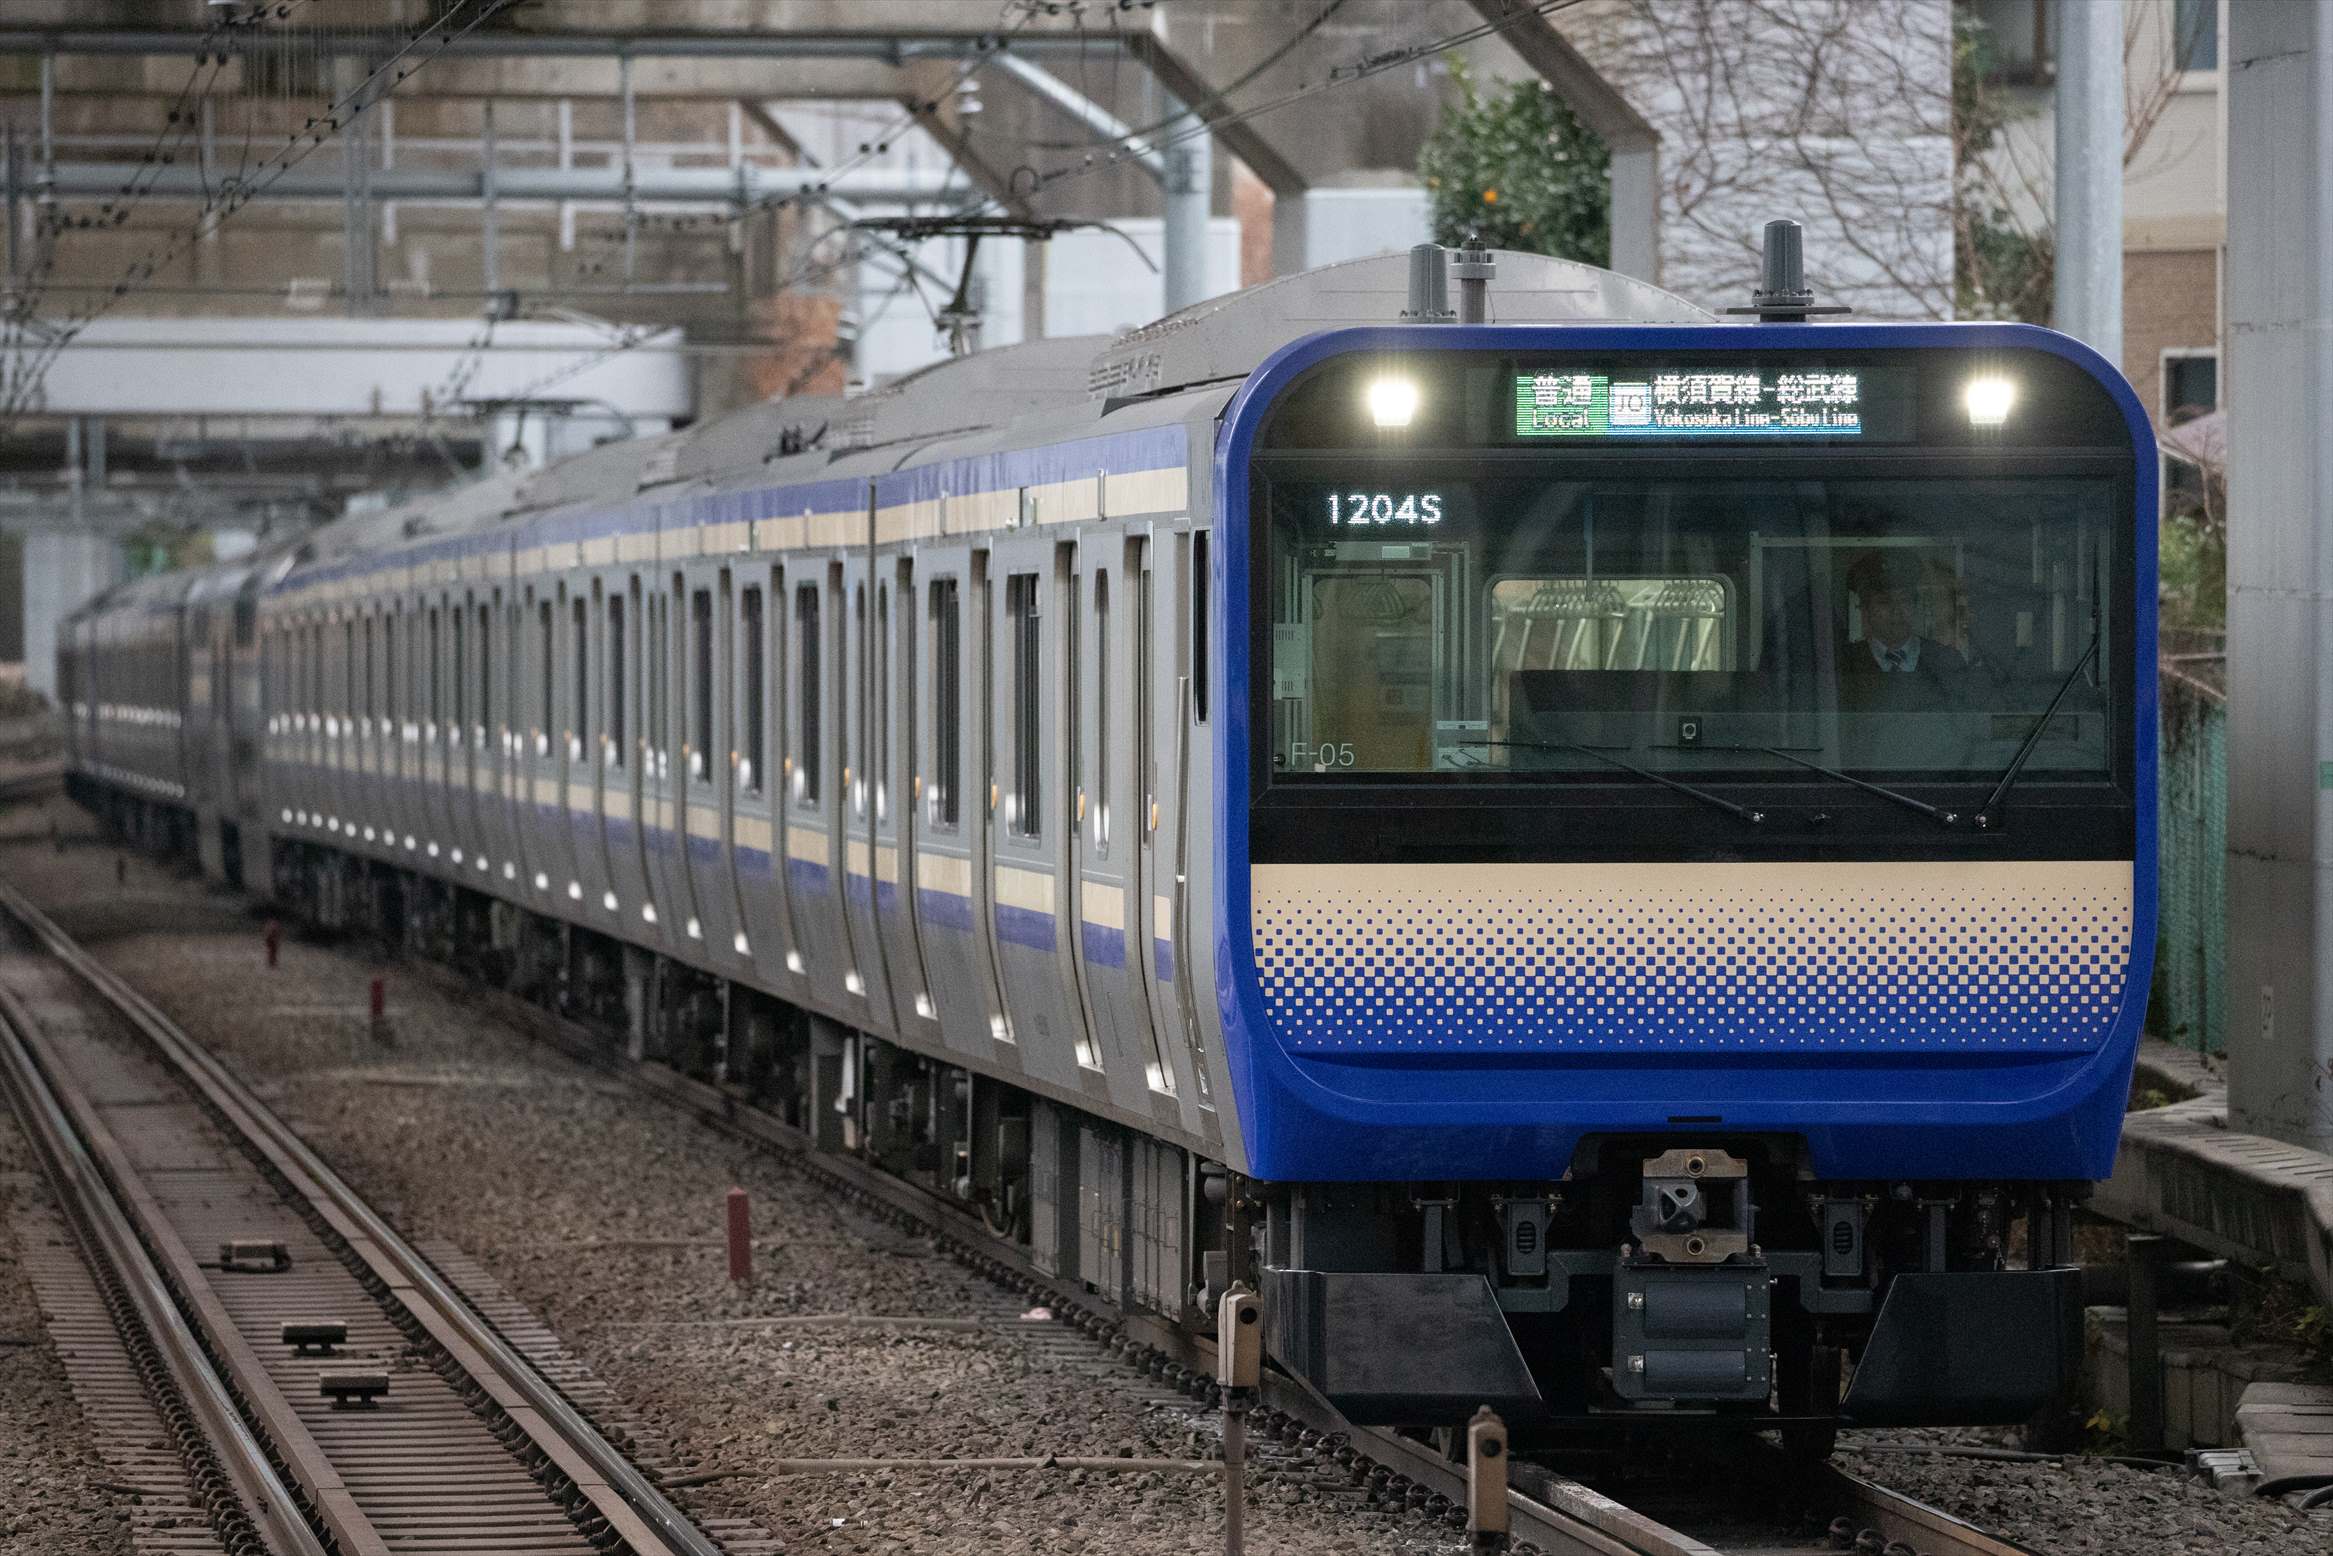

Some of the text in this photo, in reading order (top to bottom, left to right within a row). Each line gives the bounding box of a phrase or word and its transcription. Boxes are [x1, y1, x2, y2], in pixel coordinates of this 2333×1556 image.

[1532, 375, 1592, 405] 普通
[1532, 408, 1589, 428] Local
[1327, 494, 1442, 525] 1204S
[1291, 742, 1356, 767] F-05
